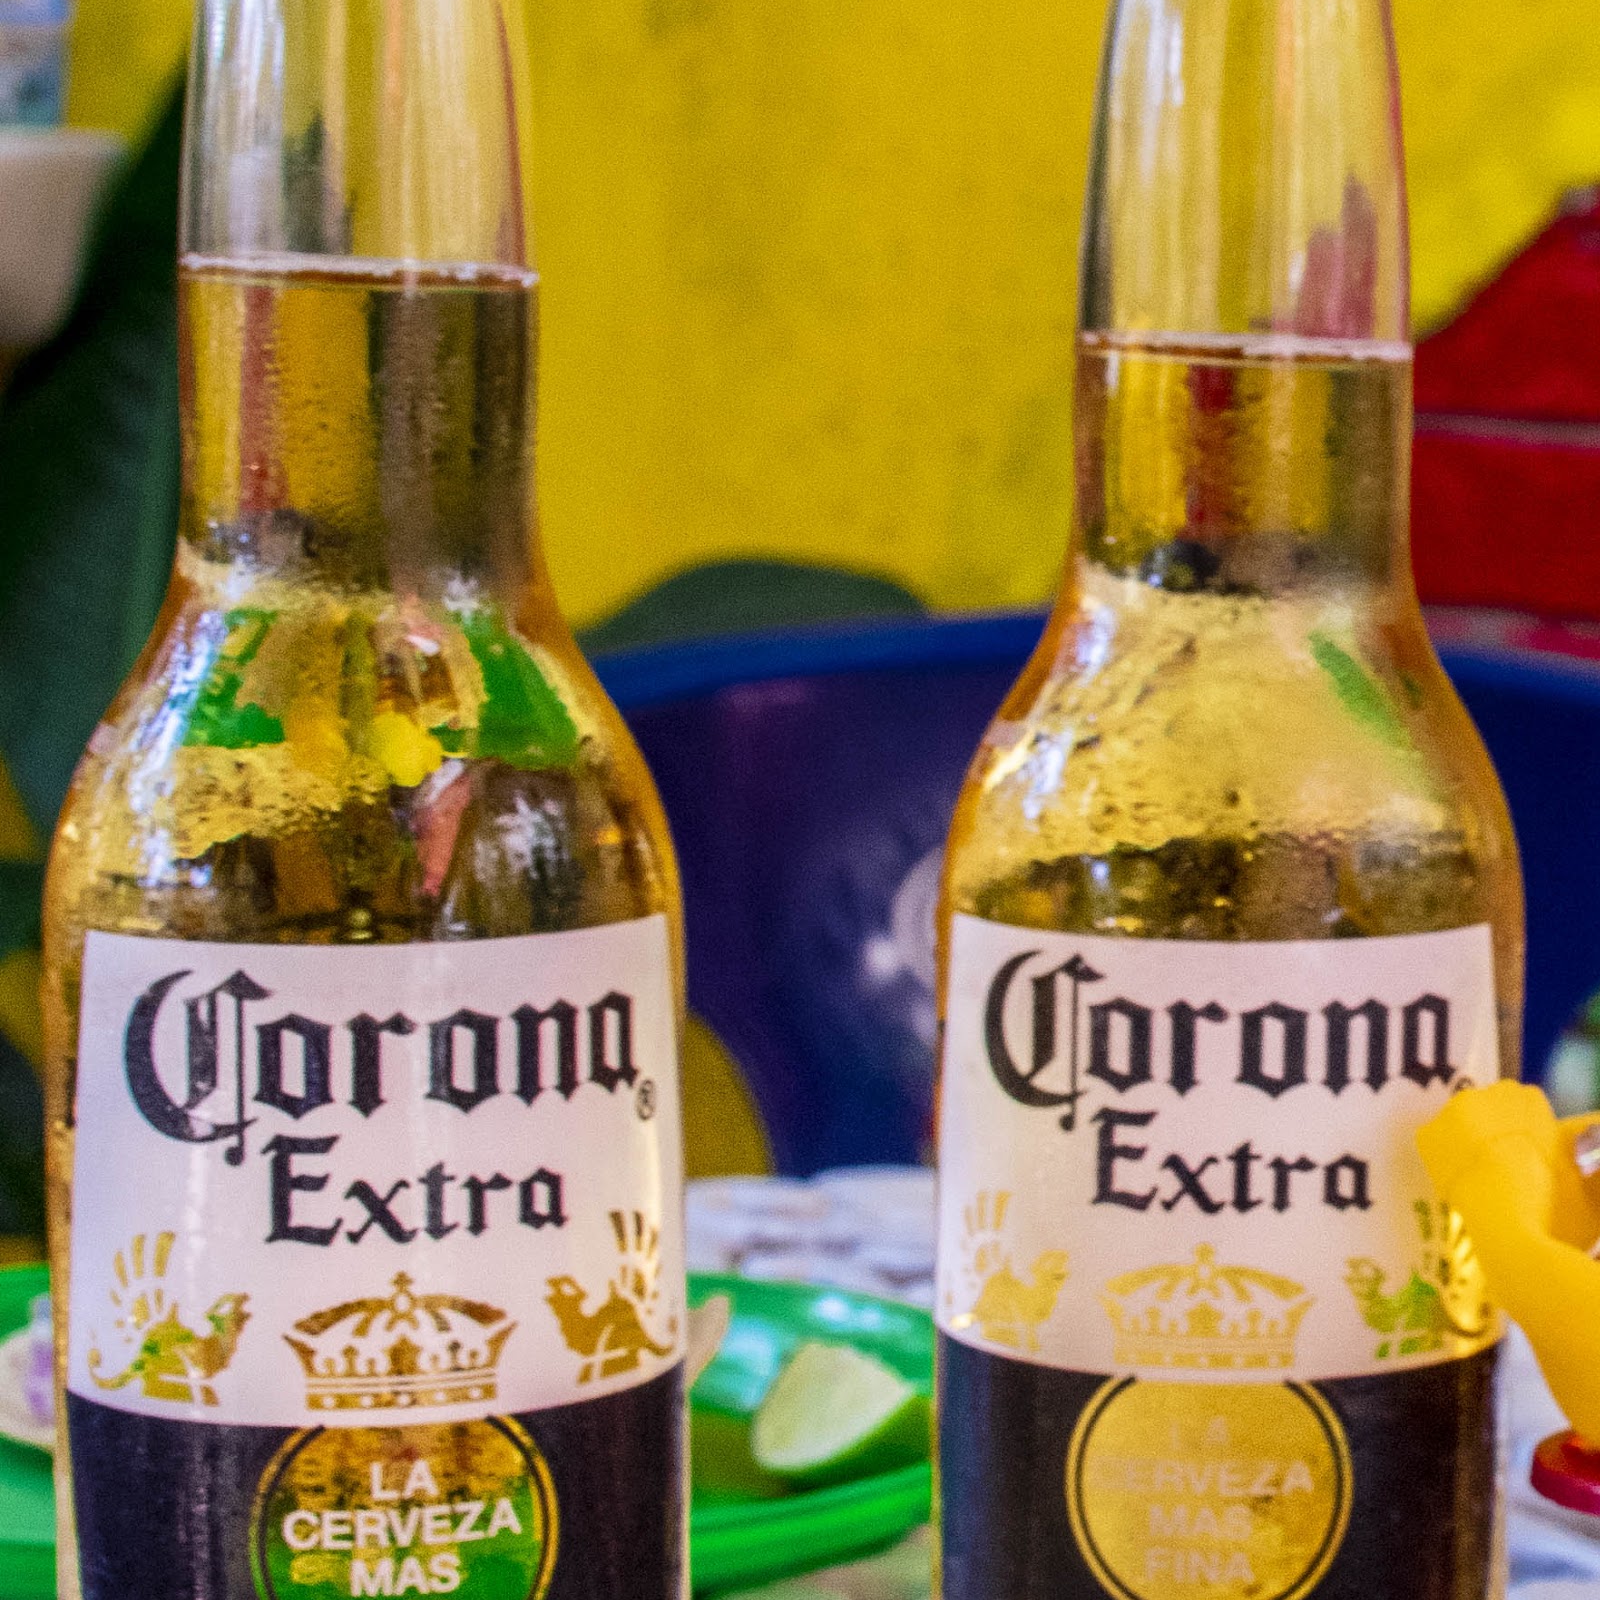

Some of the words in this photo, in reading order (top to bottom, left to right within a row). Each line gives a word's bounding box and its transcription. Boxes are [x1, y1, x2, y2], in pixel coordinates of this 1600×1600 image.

[123, 970, 638, 1165] Corona
[984, 950, 1458, 1132] Corona
[262, 1135, 568, 1246] Extra
[1092, 1107, 1371, 1214] Extra
[282, 1497, 522, 1550] CERVEZA
[370, 1458, 440, 1500] LA
[351, 1552, 461, 1598] MAS
